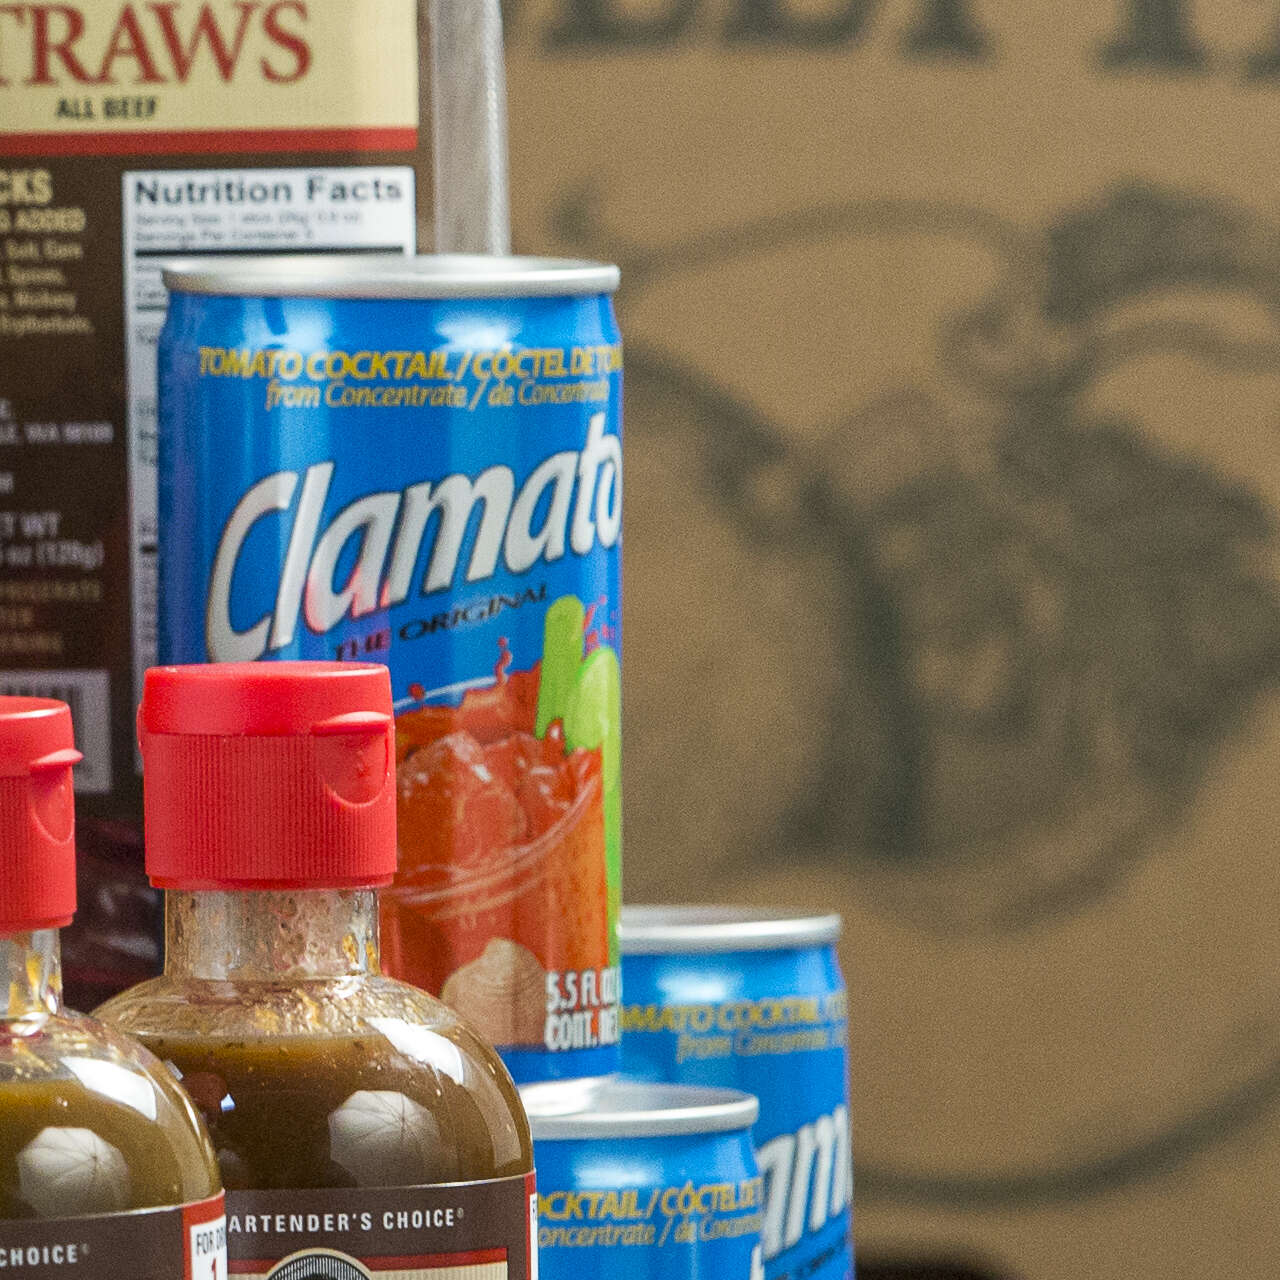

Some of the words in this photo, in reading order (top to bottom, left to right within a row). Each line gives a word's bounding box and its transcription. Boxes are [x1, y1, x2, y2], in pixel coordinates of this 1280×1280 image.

[56, 99, 96, 121] ALL
[103, 97, 159, 120] BEEF
[135, 178, 292, 205] Nutrition
[306, 175, 402, 201] Facts
[199, 346, 302, 379] TOMATO
[306, 347, 456, 380] COCKTAIL
[266, 382, 319, 410] from
[326, 380, 467, 408] Concentrate
[205, 412, 623, 663] Clamato
[335, 628, 391, 661] THE
[228, 1212, 373, 1234] ARTENDER'S
[383, 1208, 455, 1231] CHOICE
[538, 1223, 656, 1249] oncentrate
